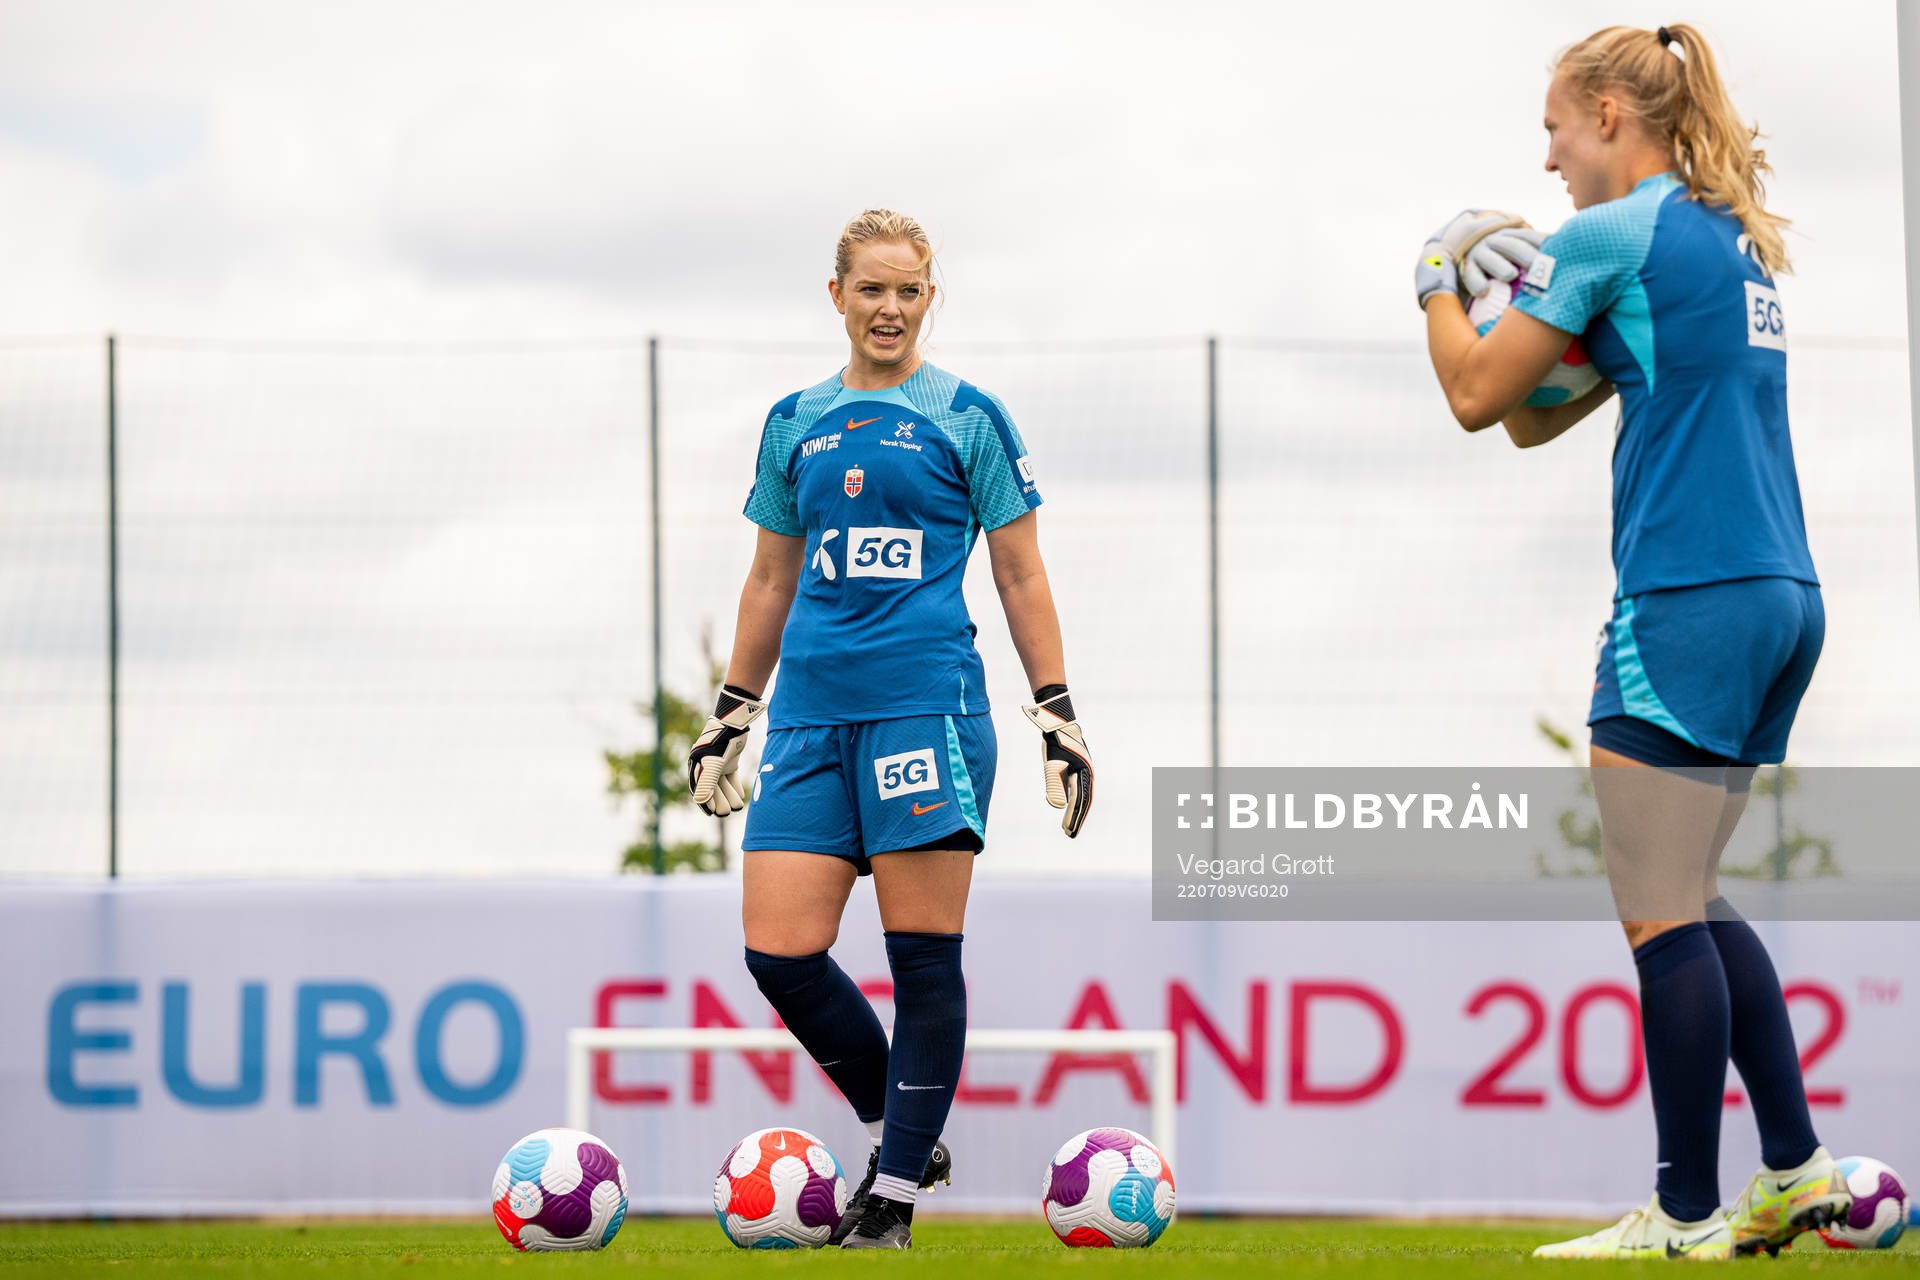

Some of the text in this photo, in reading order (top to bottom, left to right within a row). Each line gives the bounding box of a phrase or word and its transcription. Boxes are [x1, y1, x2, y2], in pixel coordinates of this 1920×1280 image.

[1755, 297, 1784, 336] 5G
[801, 436, 827, 458] KIWI
[880, 439, 922, 452] Norsk Tipping
[854, 538, 912, 568] 5G
[884, 759, 928, 789] 5G
[46, 980, 525, 1109] EURO
[593, 979, 1406, 1107] ENAND
[1459, 981, 1848, 1111] 202
